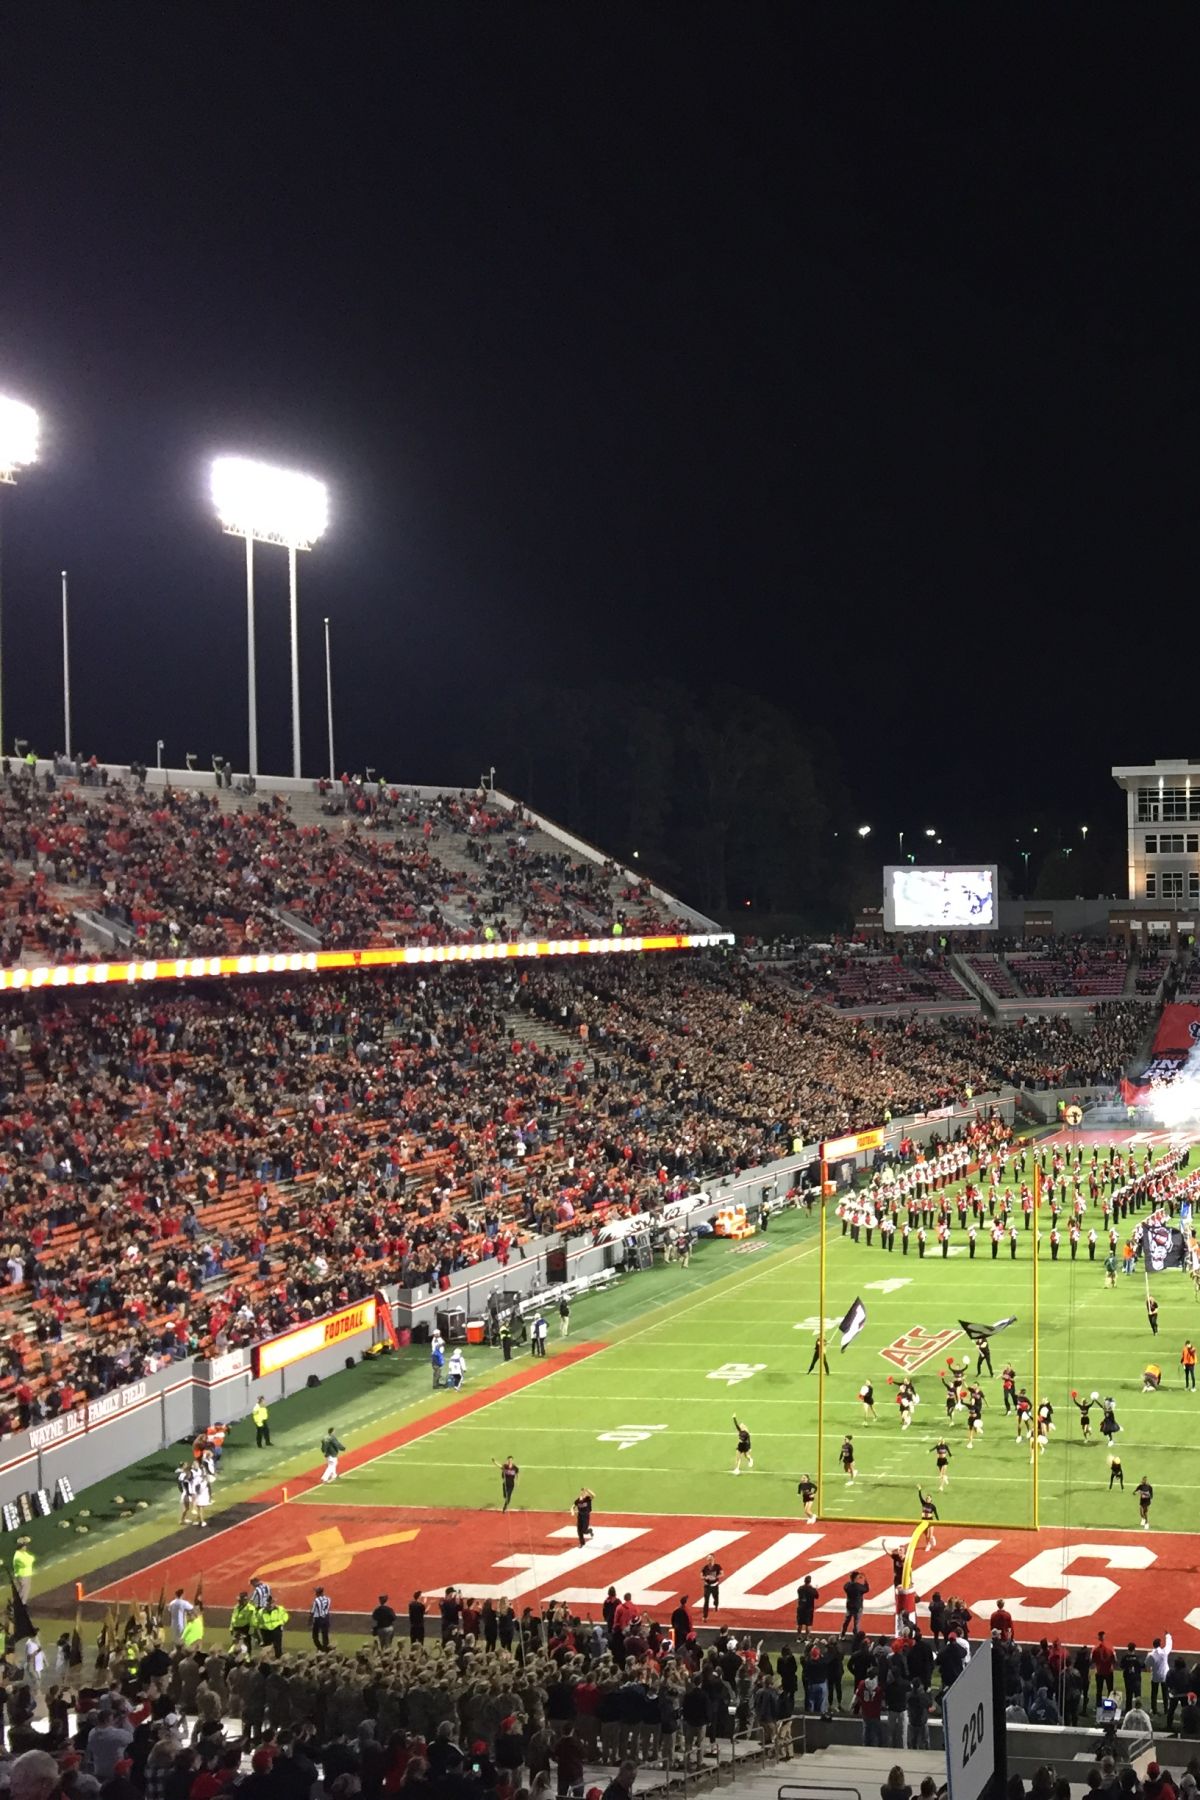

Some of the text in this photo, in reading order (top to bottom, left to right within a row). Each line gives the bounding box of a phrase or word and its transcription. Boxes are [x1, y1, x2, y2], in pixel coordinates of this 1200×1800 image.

[324, 1309, 363, 1342] FOOTBALL
[878, 1325, 955, 1371] ACC
[29, 1418, 64, 1448] WAYNE
[88, 1393, 121, 1422] FAMILY
[122, 1381, 146, 1407] FIELD
[596, 1424, 669, 1442] 10
[421, 1525, 1158, 1624] STATE
[961, 1701, 985, 1769] 220
